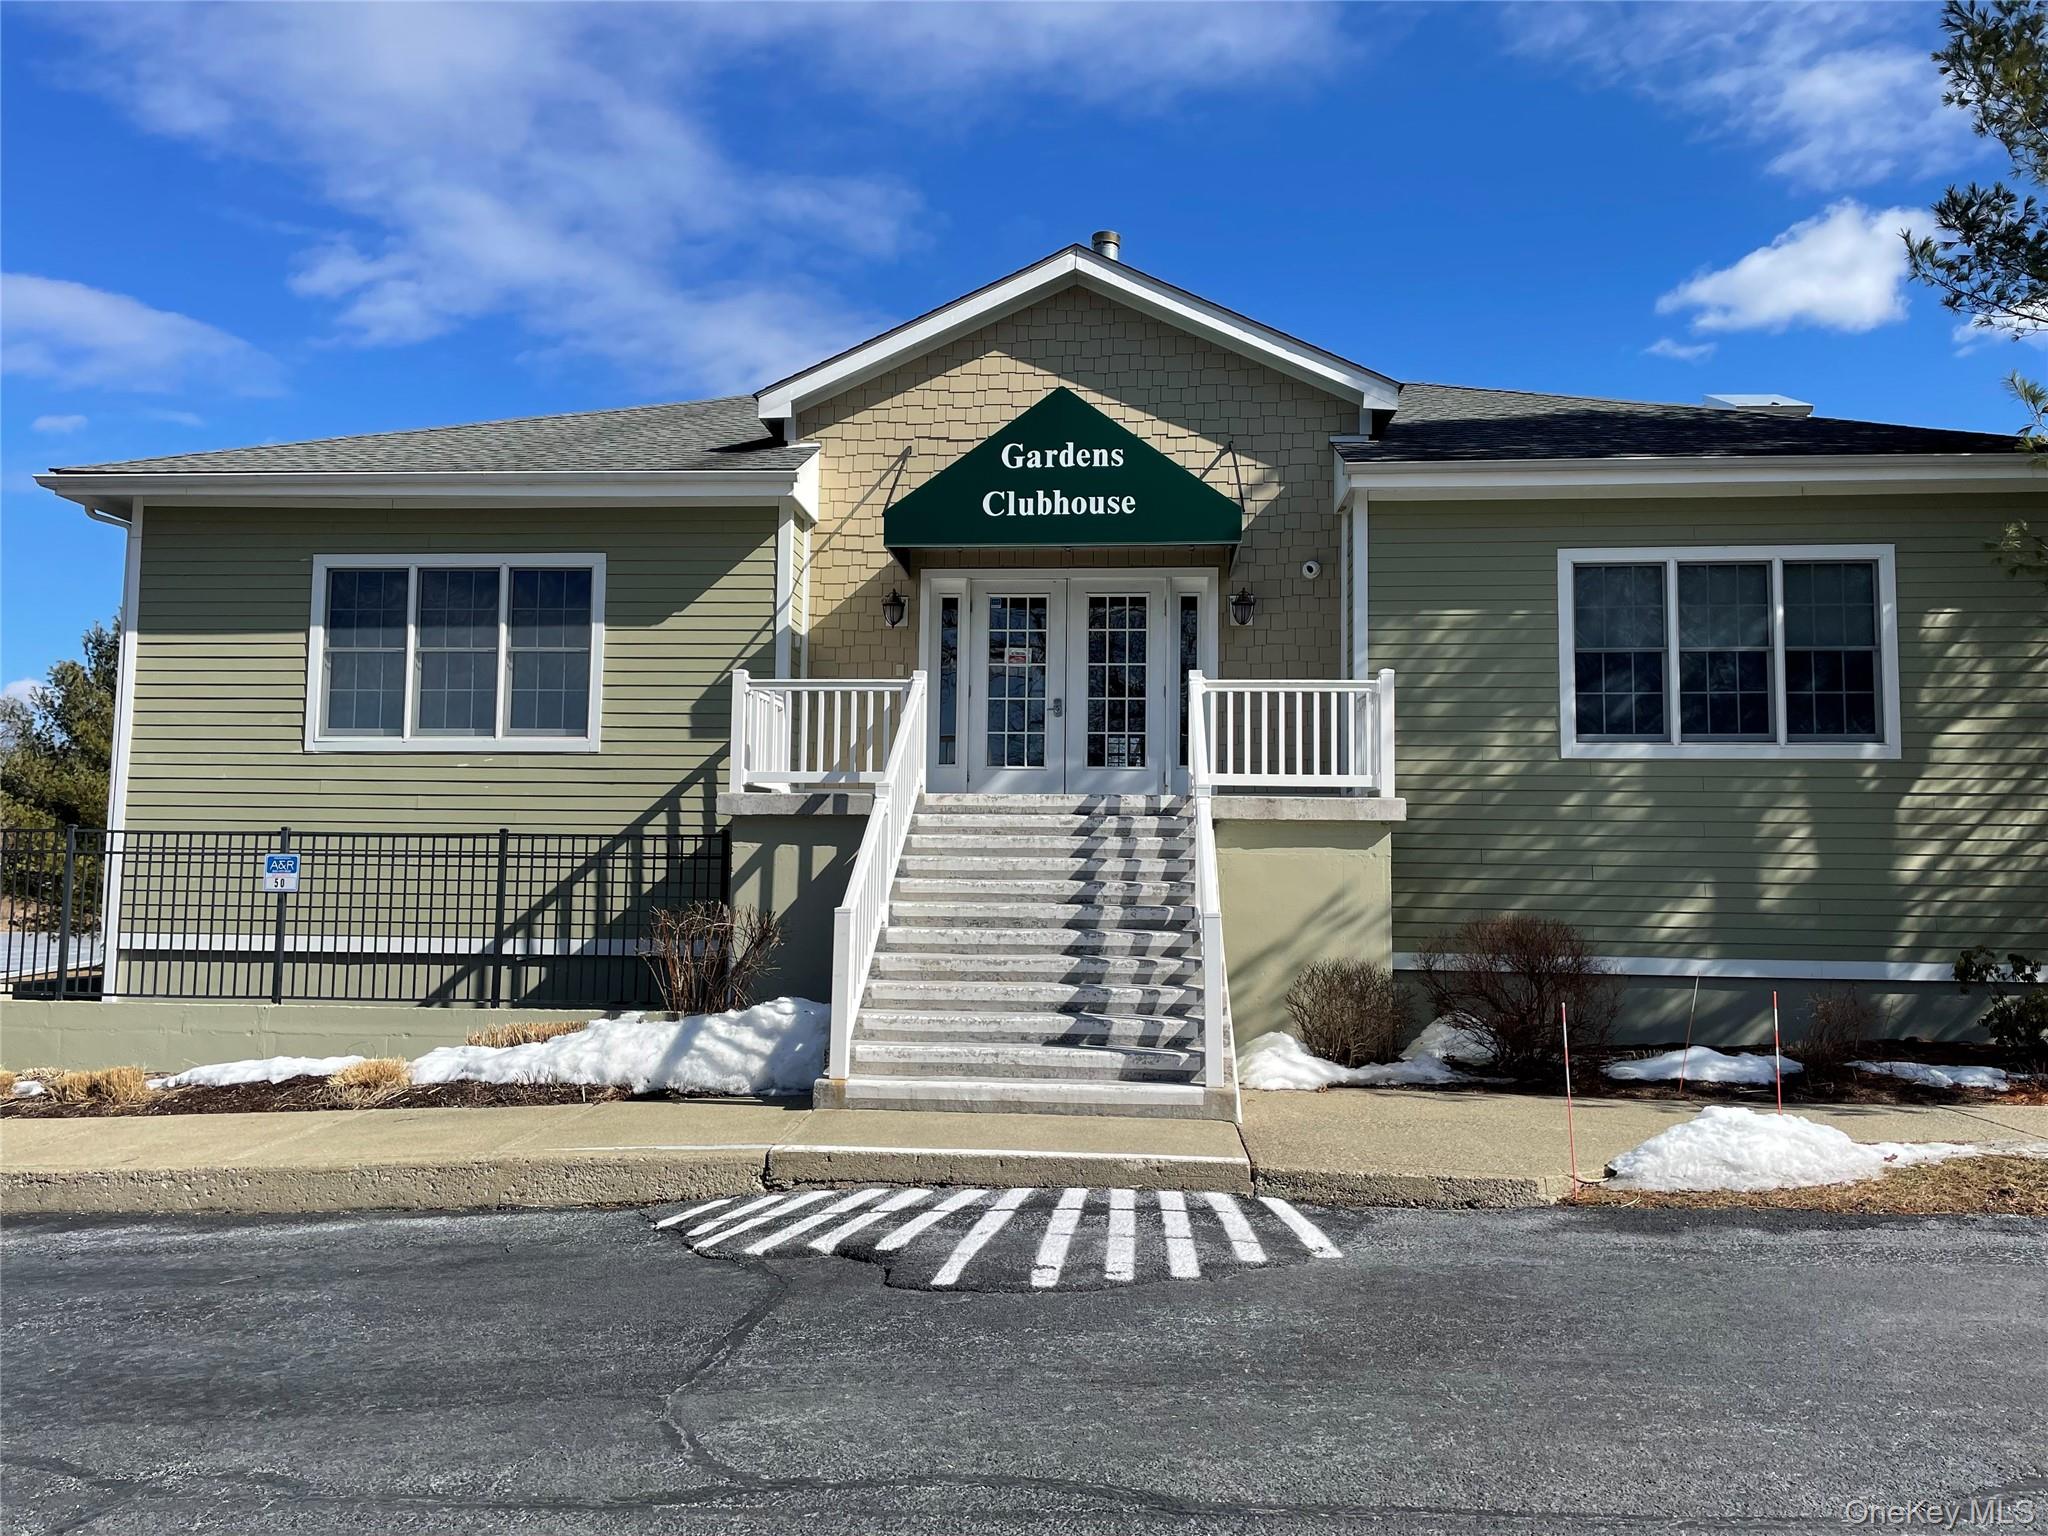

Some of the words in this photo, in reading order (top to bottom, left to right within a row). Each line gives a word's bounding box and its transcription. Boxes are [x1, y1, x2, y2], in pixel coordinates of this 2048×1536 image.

[1001, 442, 1124, 469] Gardens
[982, 490, 1136, 517] Clubhouse
[270, 860, 294, 870] A&R
